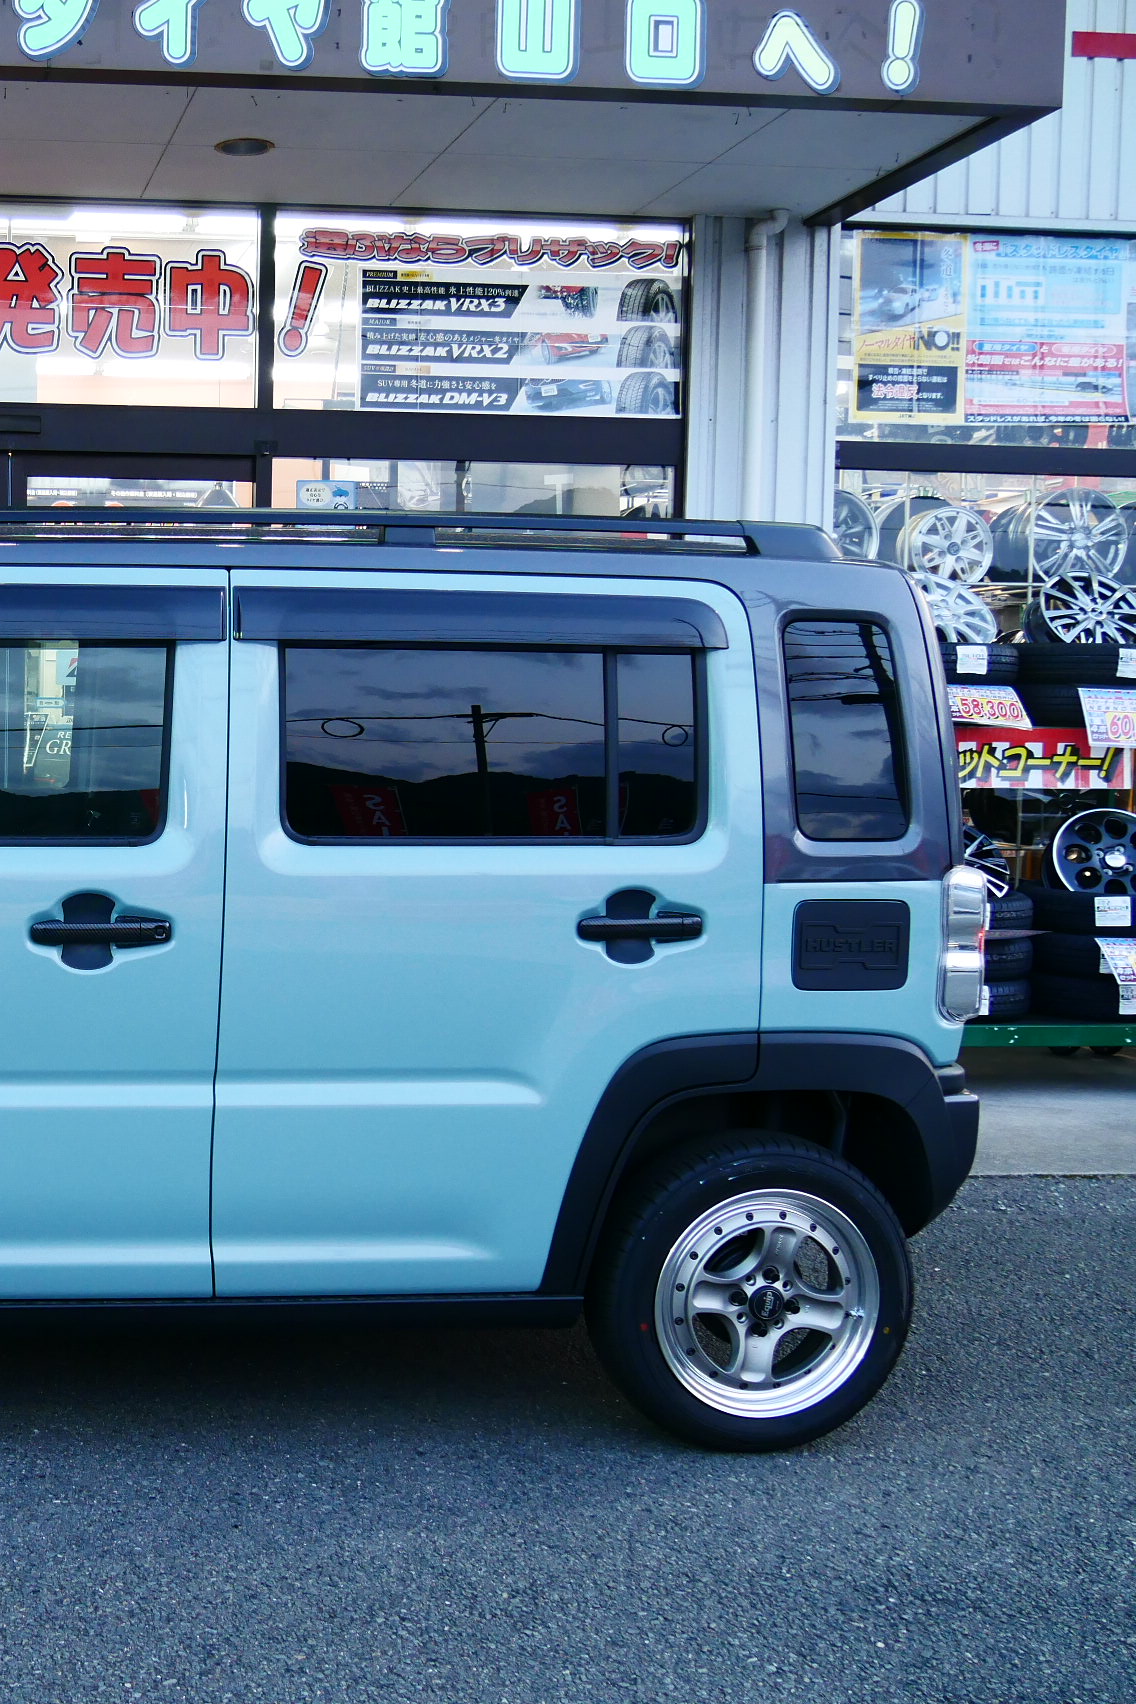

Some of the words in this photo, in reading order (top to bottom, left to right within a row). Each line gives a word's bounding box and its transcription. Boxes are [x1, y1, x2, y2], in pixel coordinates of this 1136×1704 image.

[365, 299, 449, 312] BLIZZAK
[448, 297, 507, 313] VRX3
[365, 344, 450, 357] BLIZZAK
[450, 343, 509, 360] VRX2
[365, 392, 444, 404] BLIZZAK
[442, 392, 509, 407] DM-V3
[805, 938, 895, 953] HUSTLER
